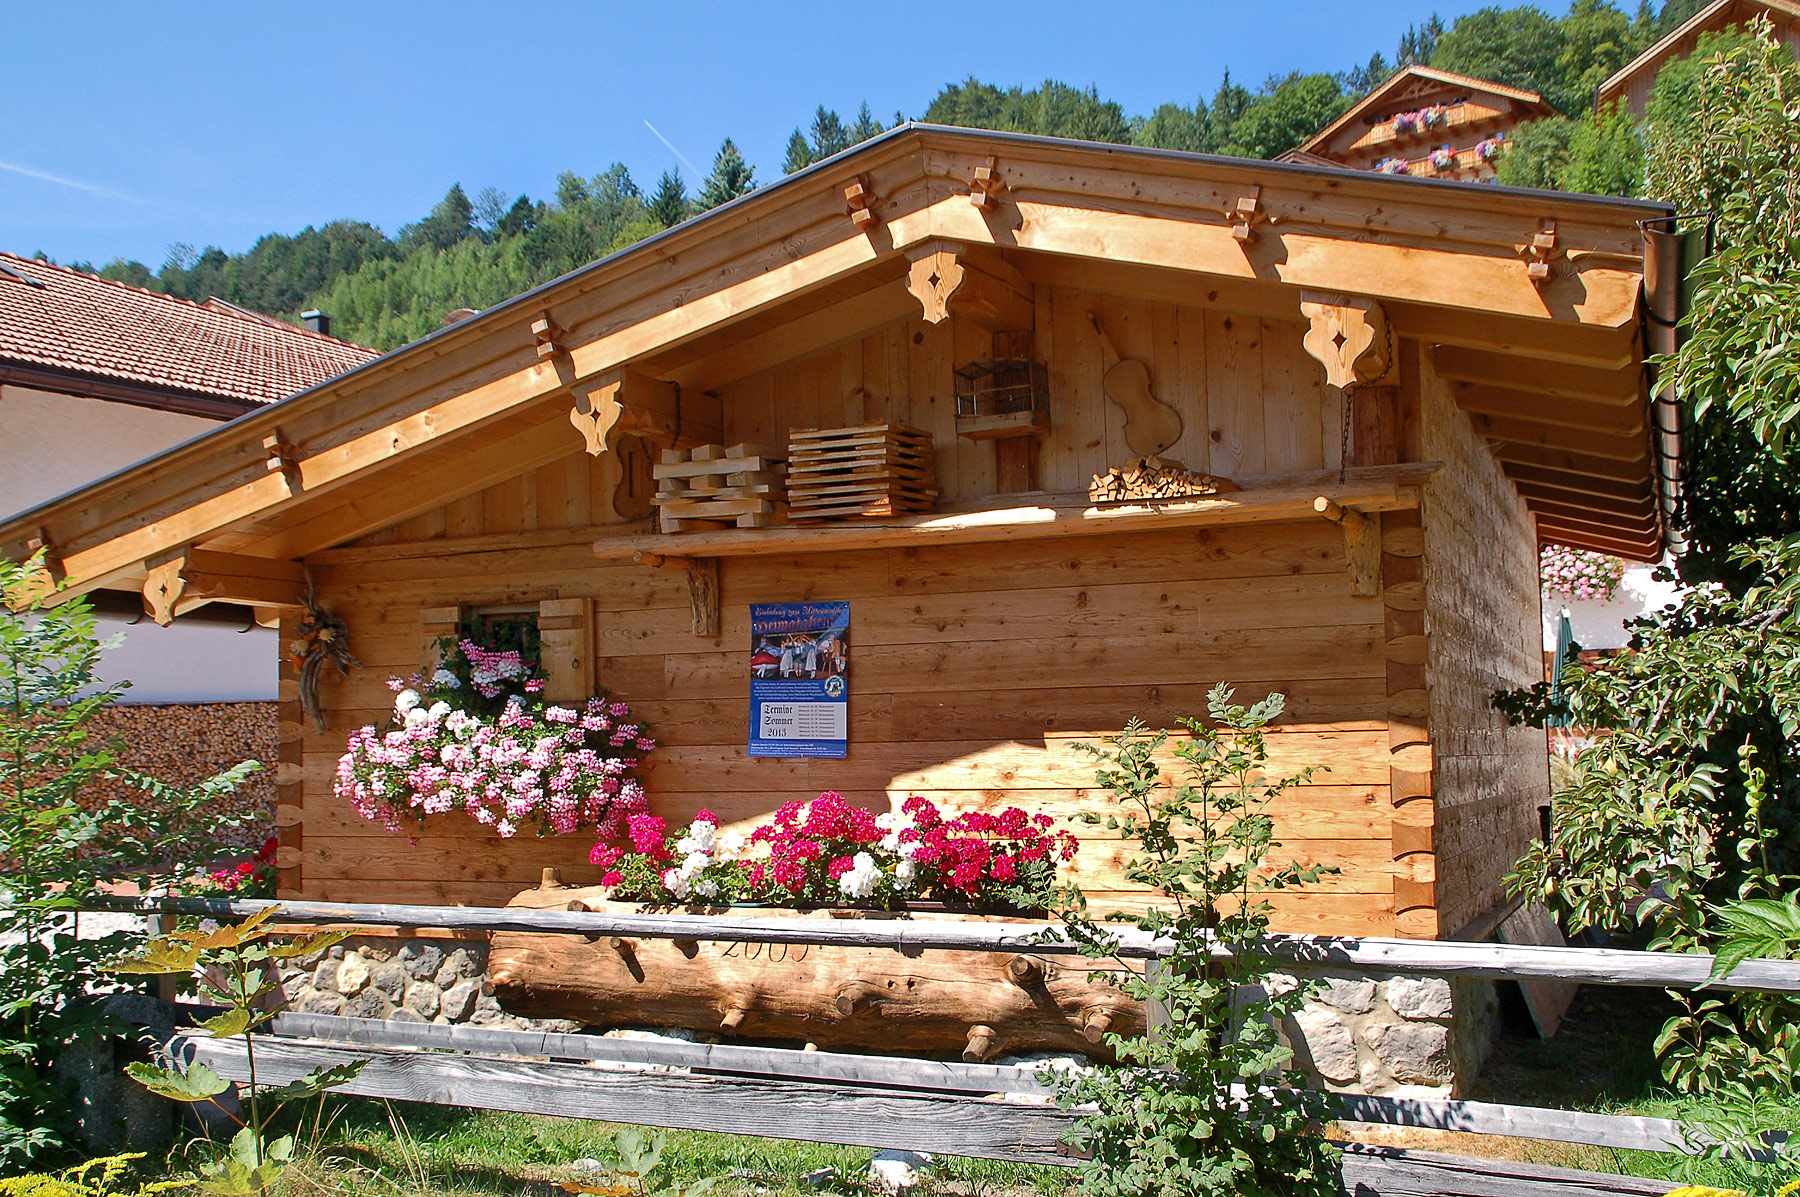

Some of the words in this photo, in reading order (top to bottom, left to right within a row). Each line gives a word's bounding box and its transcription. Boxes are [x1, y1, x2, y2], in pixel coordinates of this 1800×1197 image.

[754, 614, 840, 633] Heimatabend
[764, 704, 793, 714] Termine
[764, 715, 793, 725] Sommer
[767, 728, 787, 737] 2013
